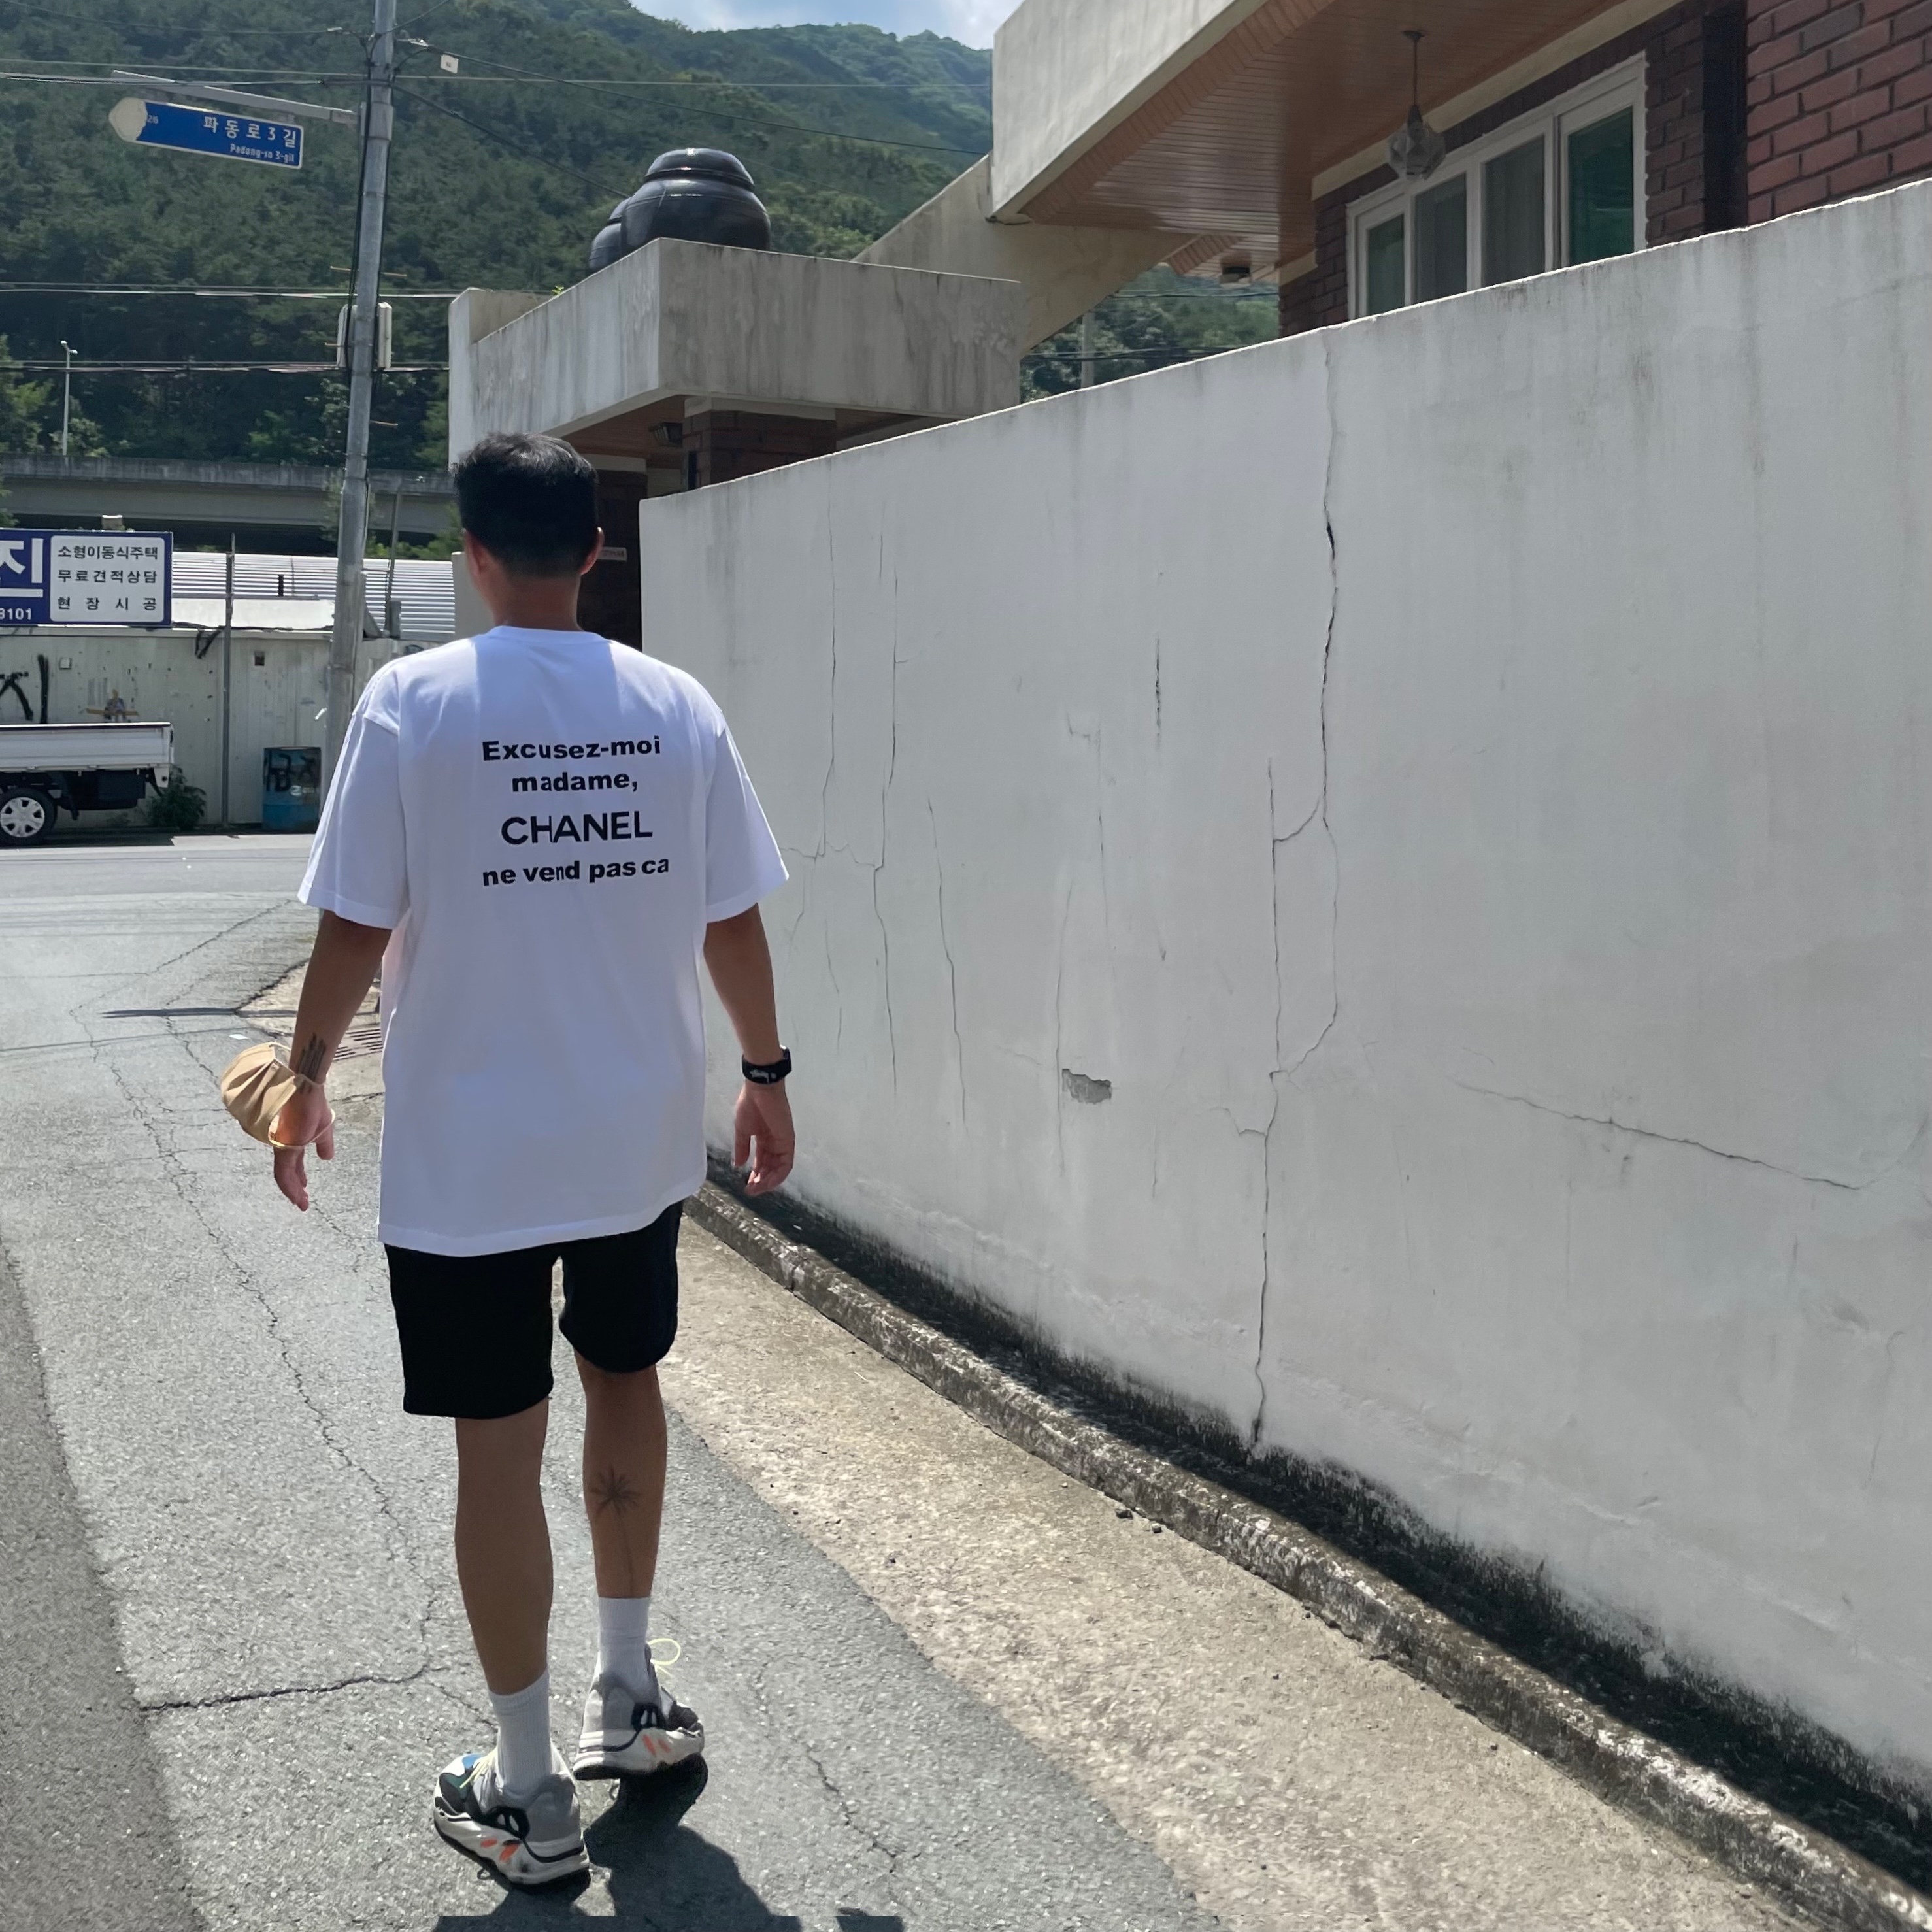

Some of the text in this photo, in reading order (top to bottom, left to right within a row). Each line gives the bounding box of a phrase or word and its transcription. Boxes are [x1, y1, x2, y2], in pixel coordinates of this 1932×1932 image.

[58, 545, 158, 560] 소형이동식주택
[482, 735, 661, 761] Excusez-moi
[512, 772, 638, 792] madame,
[501, 810, 653, 845] CHANEL
[482, 858, 669, 886] ne vend pas ca
